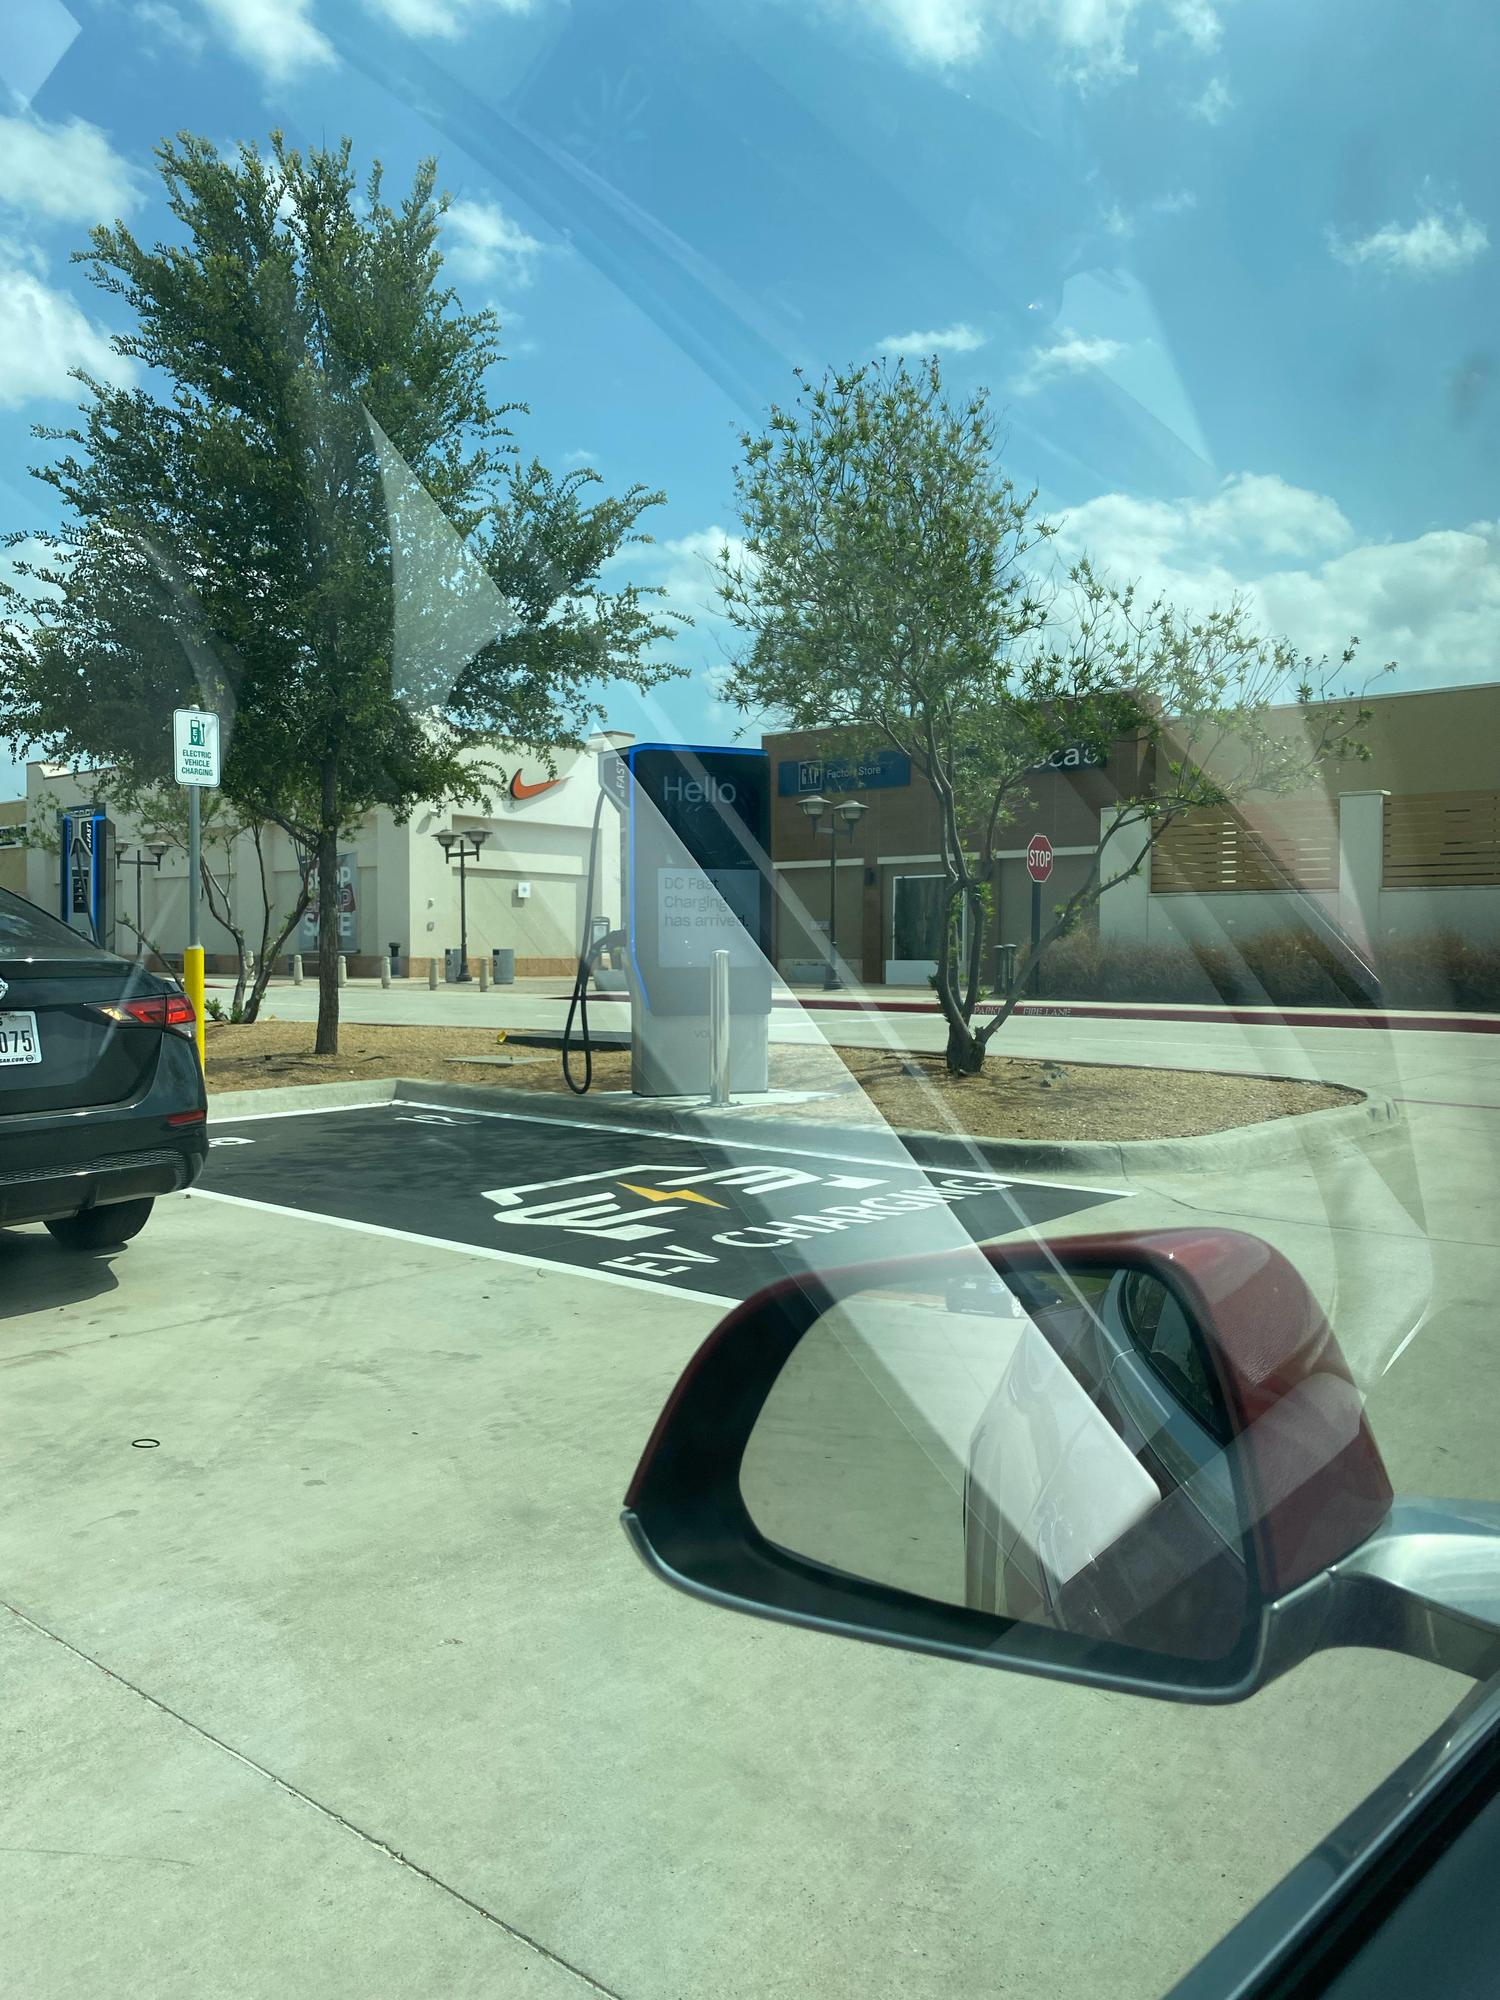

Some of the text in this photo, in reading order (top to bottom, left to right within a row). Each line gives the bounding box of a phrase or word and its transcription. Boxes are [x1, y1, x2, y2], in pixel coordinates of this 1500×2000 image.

[182, 749, 212, 759] ELECTRIC
[184, 758, 210, 767] VEHICLE
[181, 766, 213, 776] CHARGING
[801, 766, 881, 785] GAP Facto Store
[663, 775, 737, 803] Hello
[1029, 849, 1052, 867] STOP
[663, 877, 719, 890] DC Fast
[663, 896, 727, 912] Charging
[303, 912, 352, 935] SE
[664, 914, 749, 927] has arrived.
[1023, 1007, 1045, 1015] FIRE
[1046, 1008, 1072, 1016] LANE
[599, 1178, 1014, 1277] EV CHARGING
